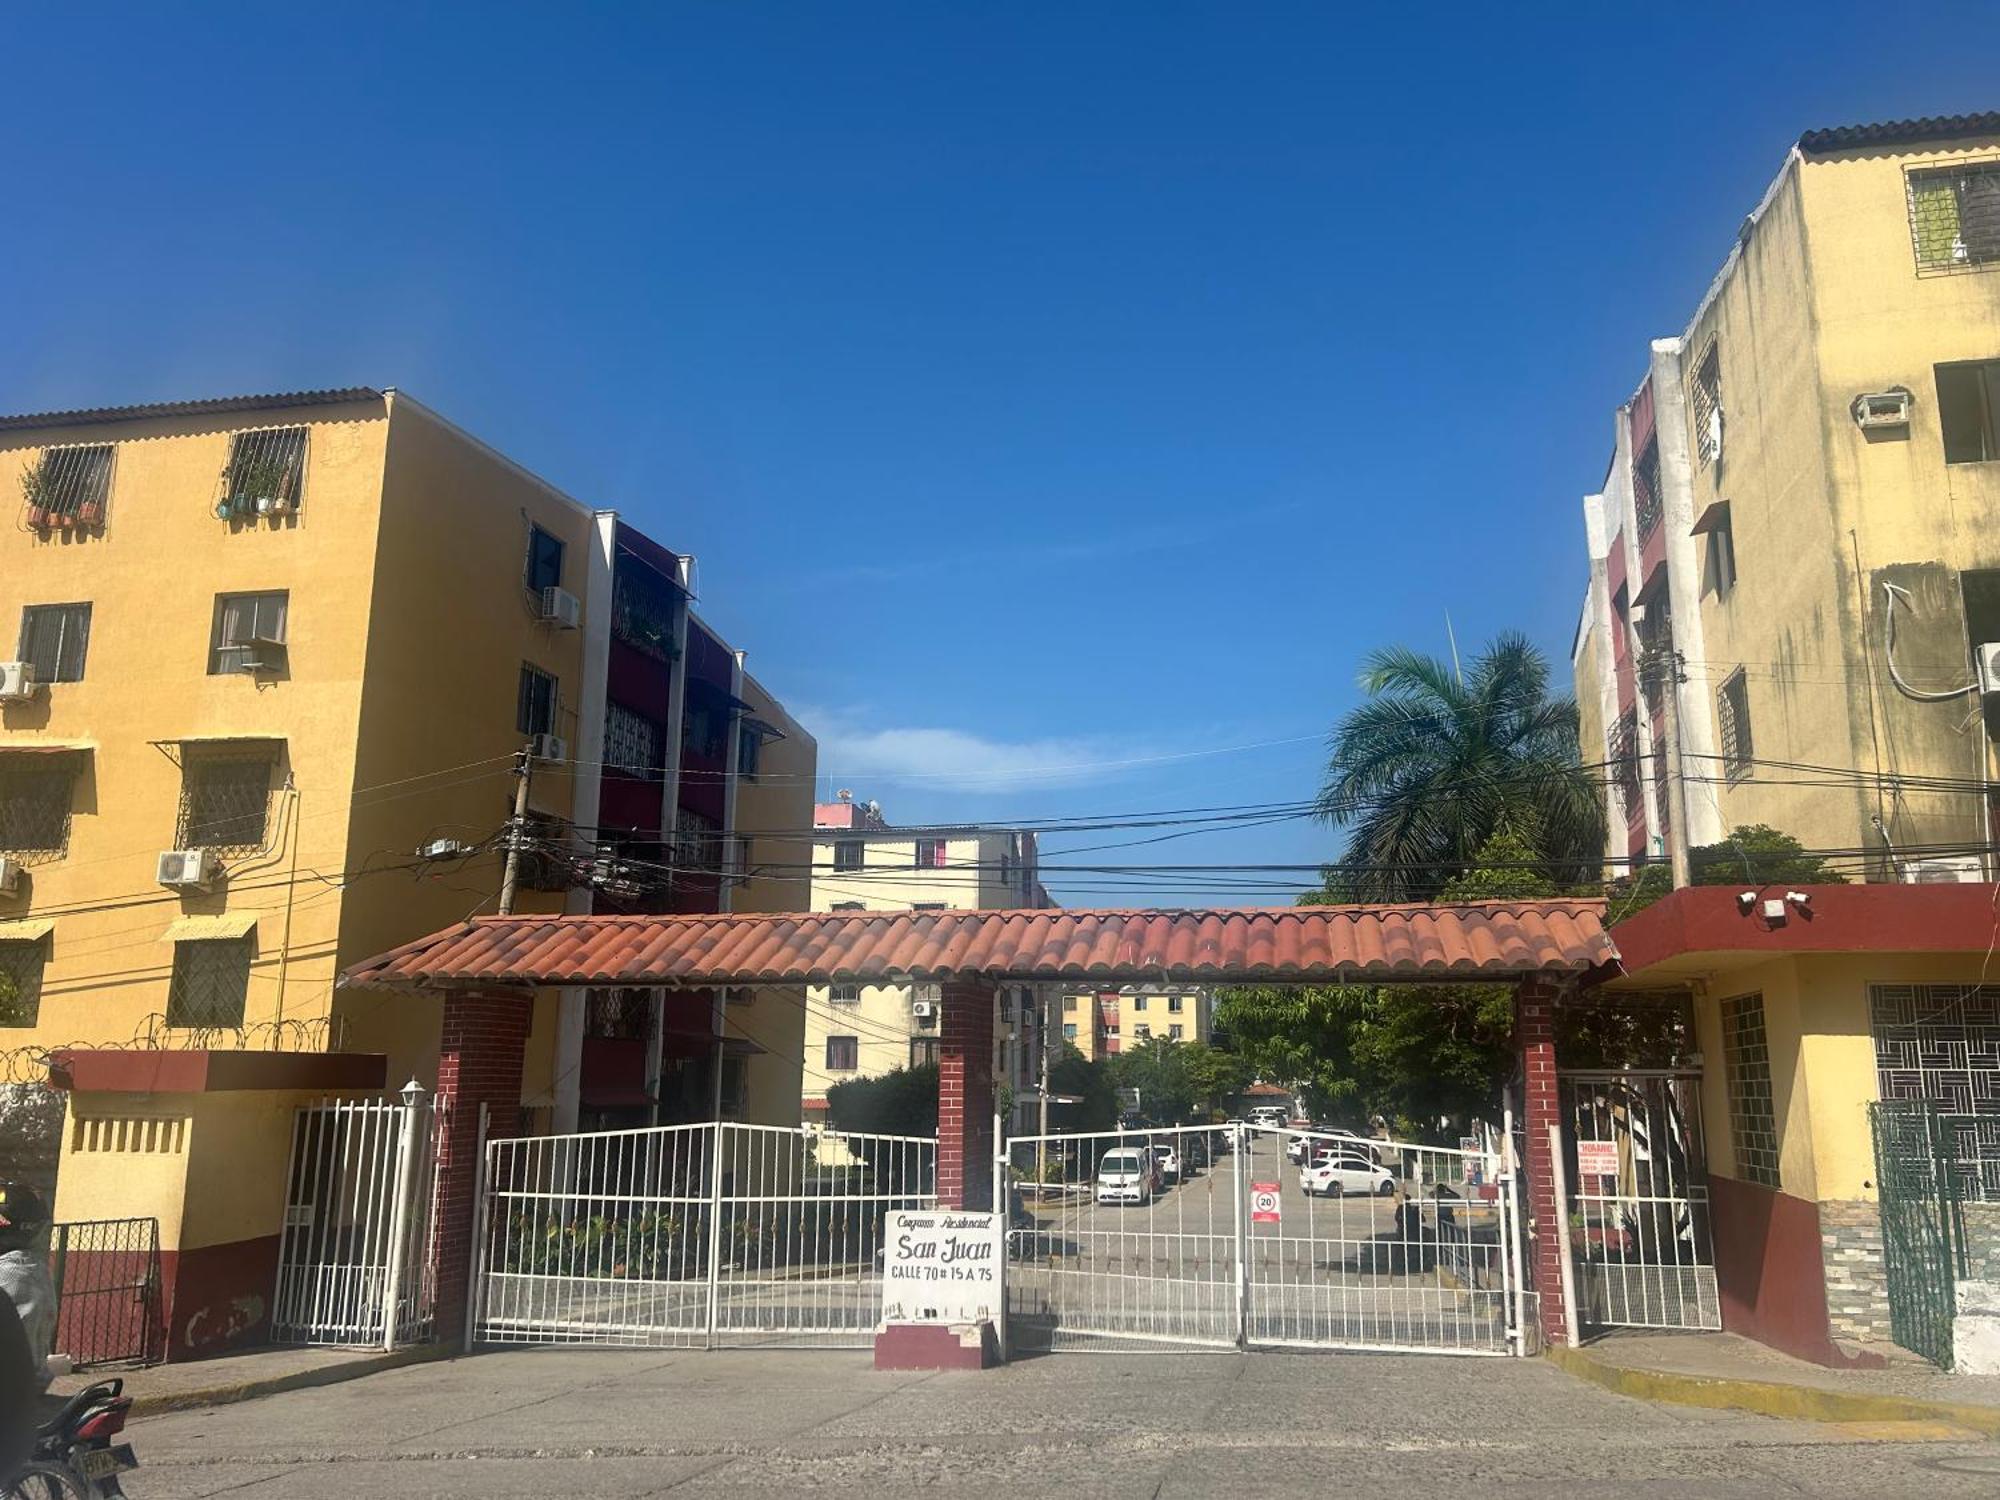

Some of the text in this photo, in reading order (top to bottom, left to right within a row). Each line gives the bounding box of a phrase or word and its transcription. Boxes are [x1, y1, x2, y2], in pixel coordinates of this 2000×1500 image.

[1261, 1198, 1271, 1206] 20
[896, 1235, 992, 1263] San Juan
[891, 1265, 921, 1279] CALLE
[924, 1266, 938, 1281] 70
[951, 1267, 964, 1280] 15
[965, 1268, 974, 1281] A
[978, 1268, 992, 1281] 75
